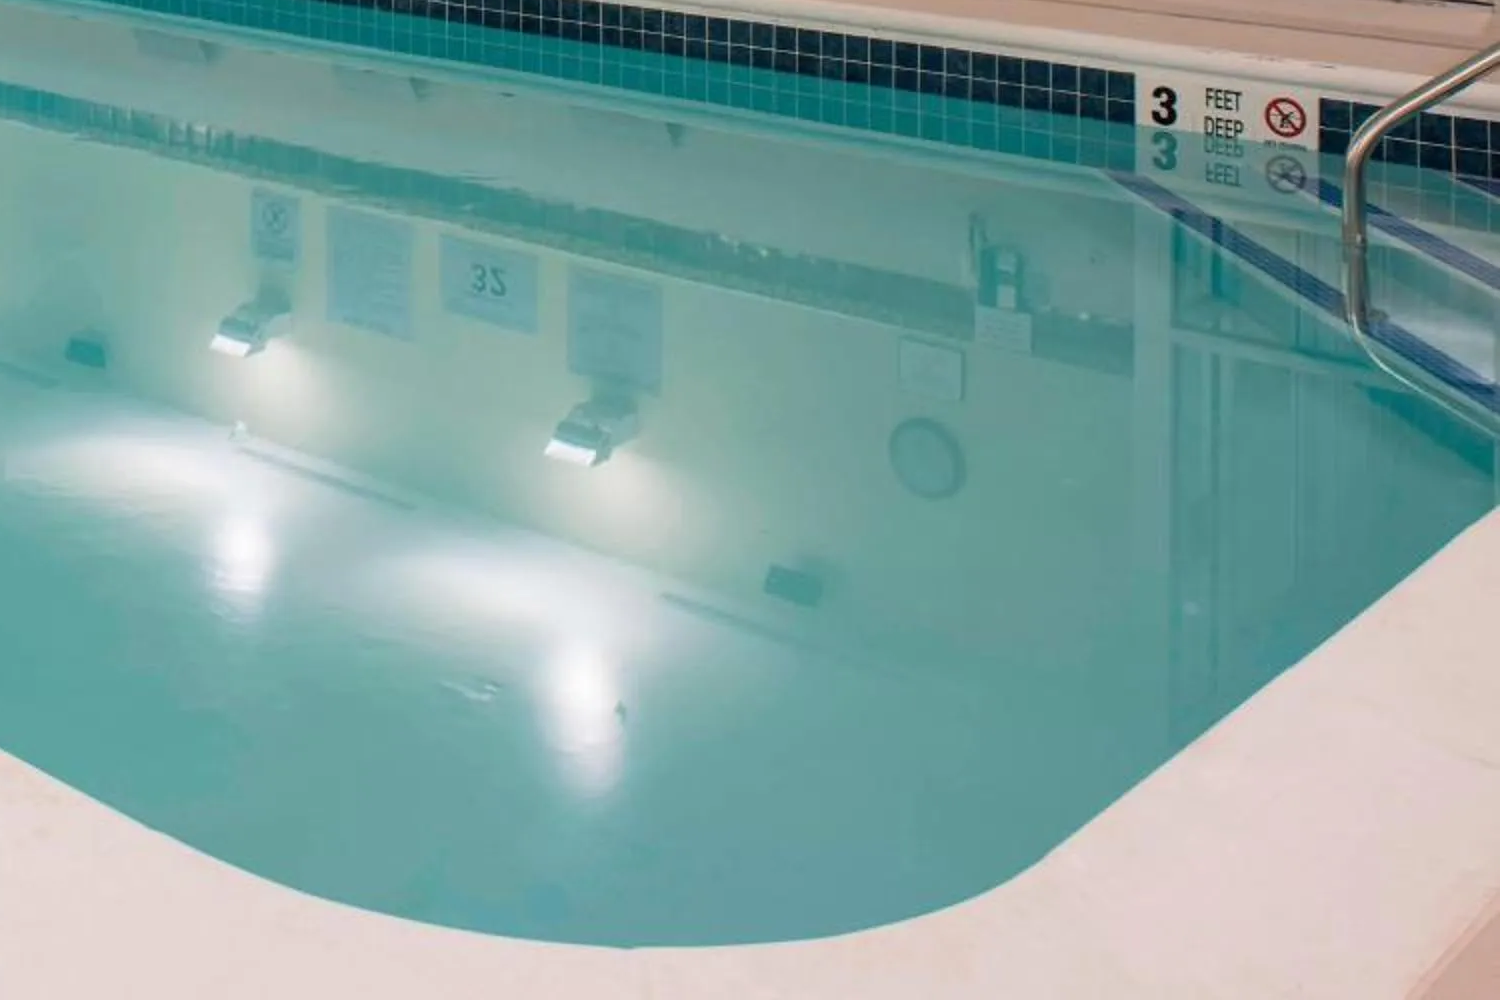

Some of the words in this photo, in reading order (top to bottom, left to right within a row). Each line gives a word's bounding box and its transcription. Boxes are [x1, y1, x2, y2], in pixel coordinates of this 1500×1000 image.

[1151, 86, 1177, 126] 3
[1205, 87, 1243, 113] FEET
[1203, 115, 1244, 139] DEEP
